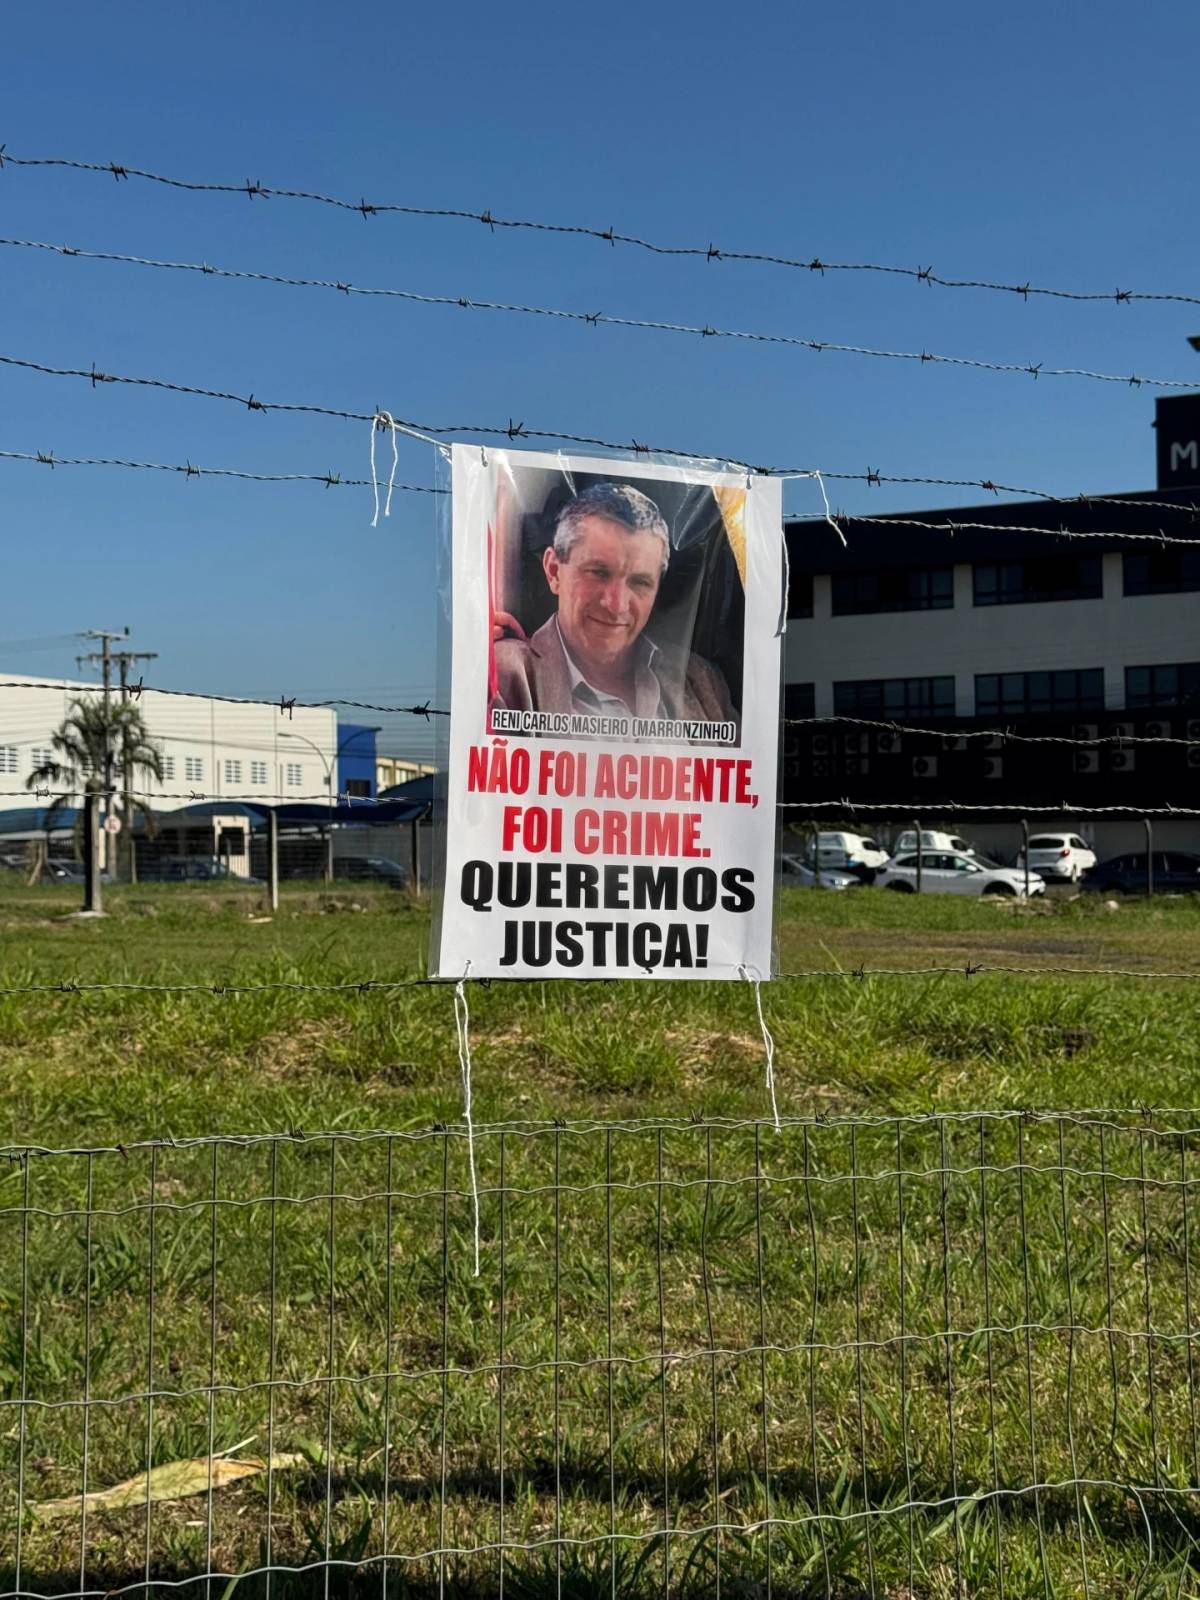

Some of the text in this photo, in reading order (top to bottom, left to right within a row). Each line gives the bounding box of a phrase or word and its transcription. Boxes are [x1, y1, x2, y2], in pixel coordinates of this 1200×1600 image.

[493, 711, 735, 741] RENI CARLOS MASIEIRO (MARRONZINHO)
[468, 738, 759, 809] NÃO FOI ACIDENTE,
[502, 806, 711, 858] FOI CRIME.
[460, 860, 755, 913] QUEREMOS
[500, 920, 709, 974] JUSTIÇA!
